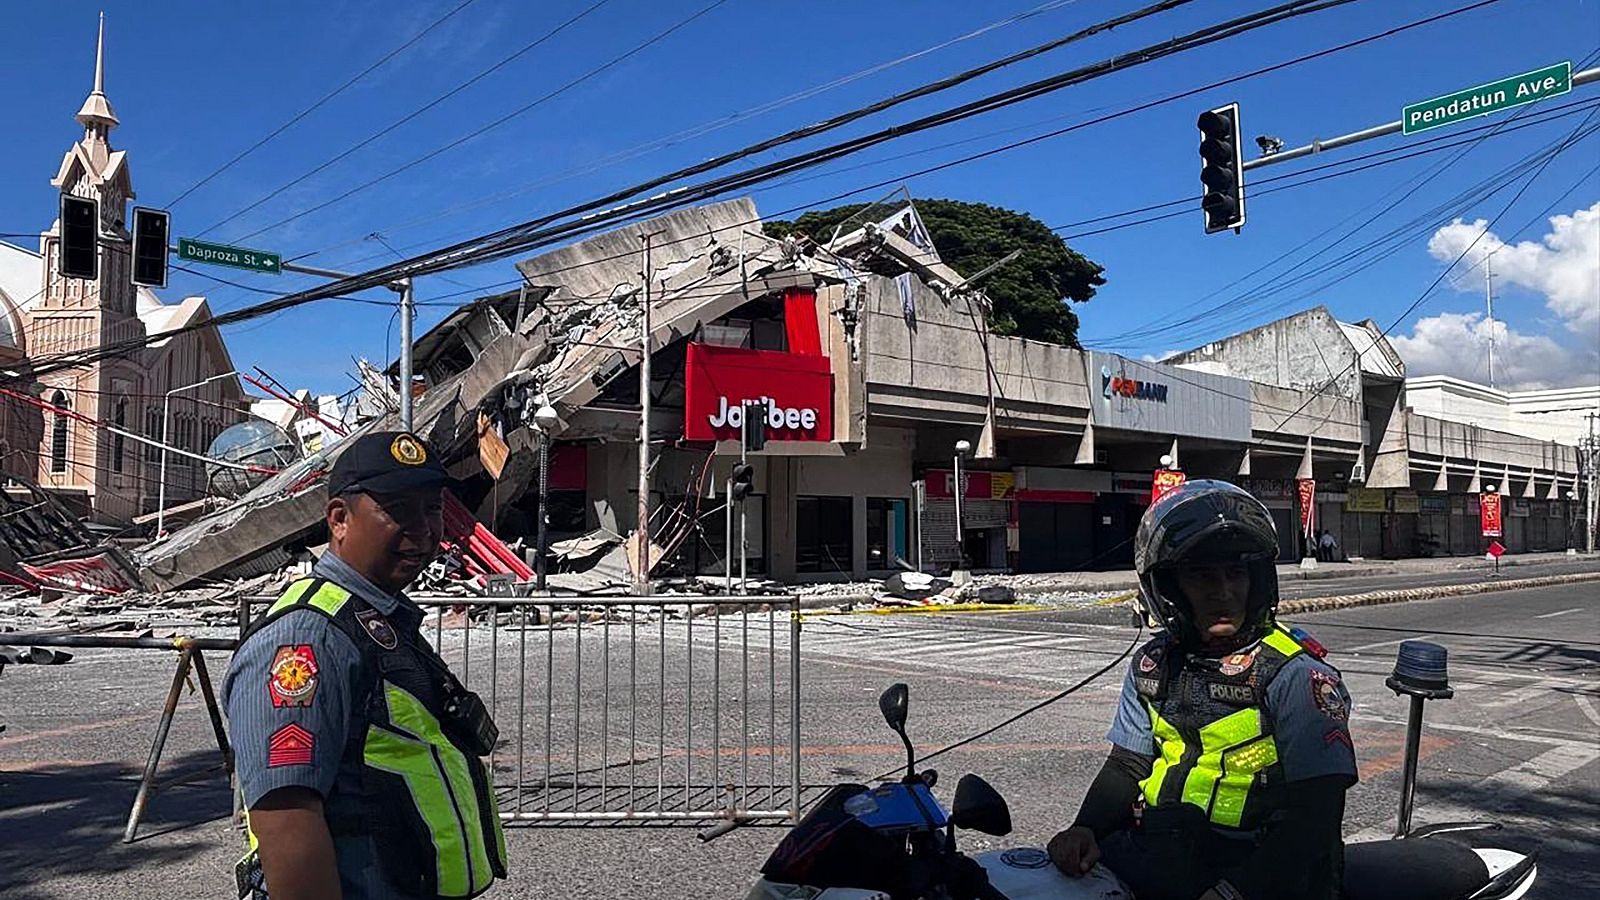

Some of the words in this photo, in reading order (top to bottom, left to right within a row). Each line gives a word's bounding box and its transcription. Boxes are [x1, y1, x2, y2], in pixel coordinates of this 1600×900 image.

[1411, 90, 1505, 126] Pendatun
[1516, 75, 1562, 98] Ave.
[187, 244, 239, 262] Daproza
[243, 253, 259, 266] St.
[709, 396, 817, 429] Joibee
[1210, 684, 1253, 700] POLICE
